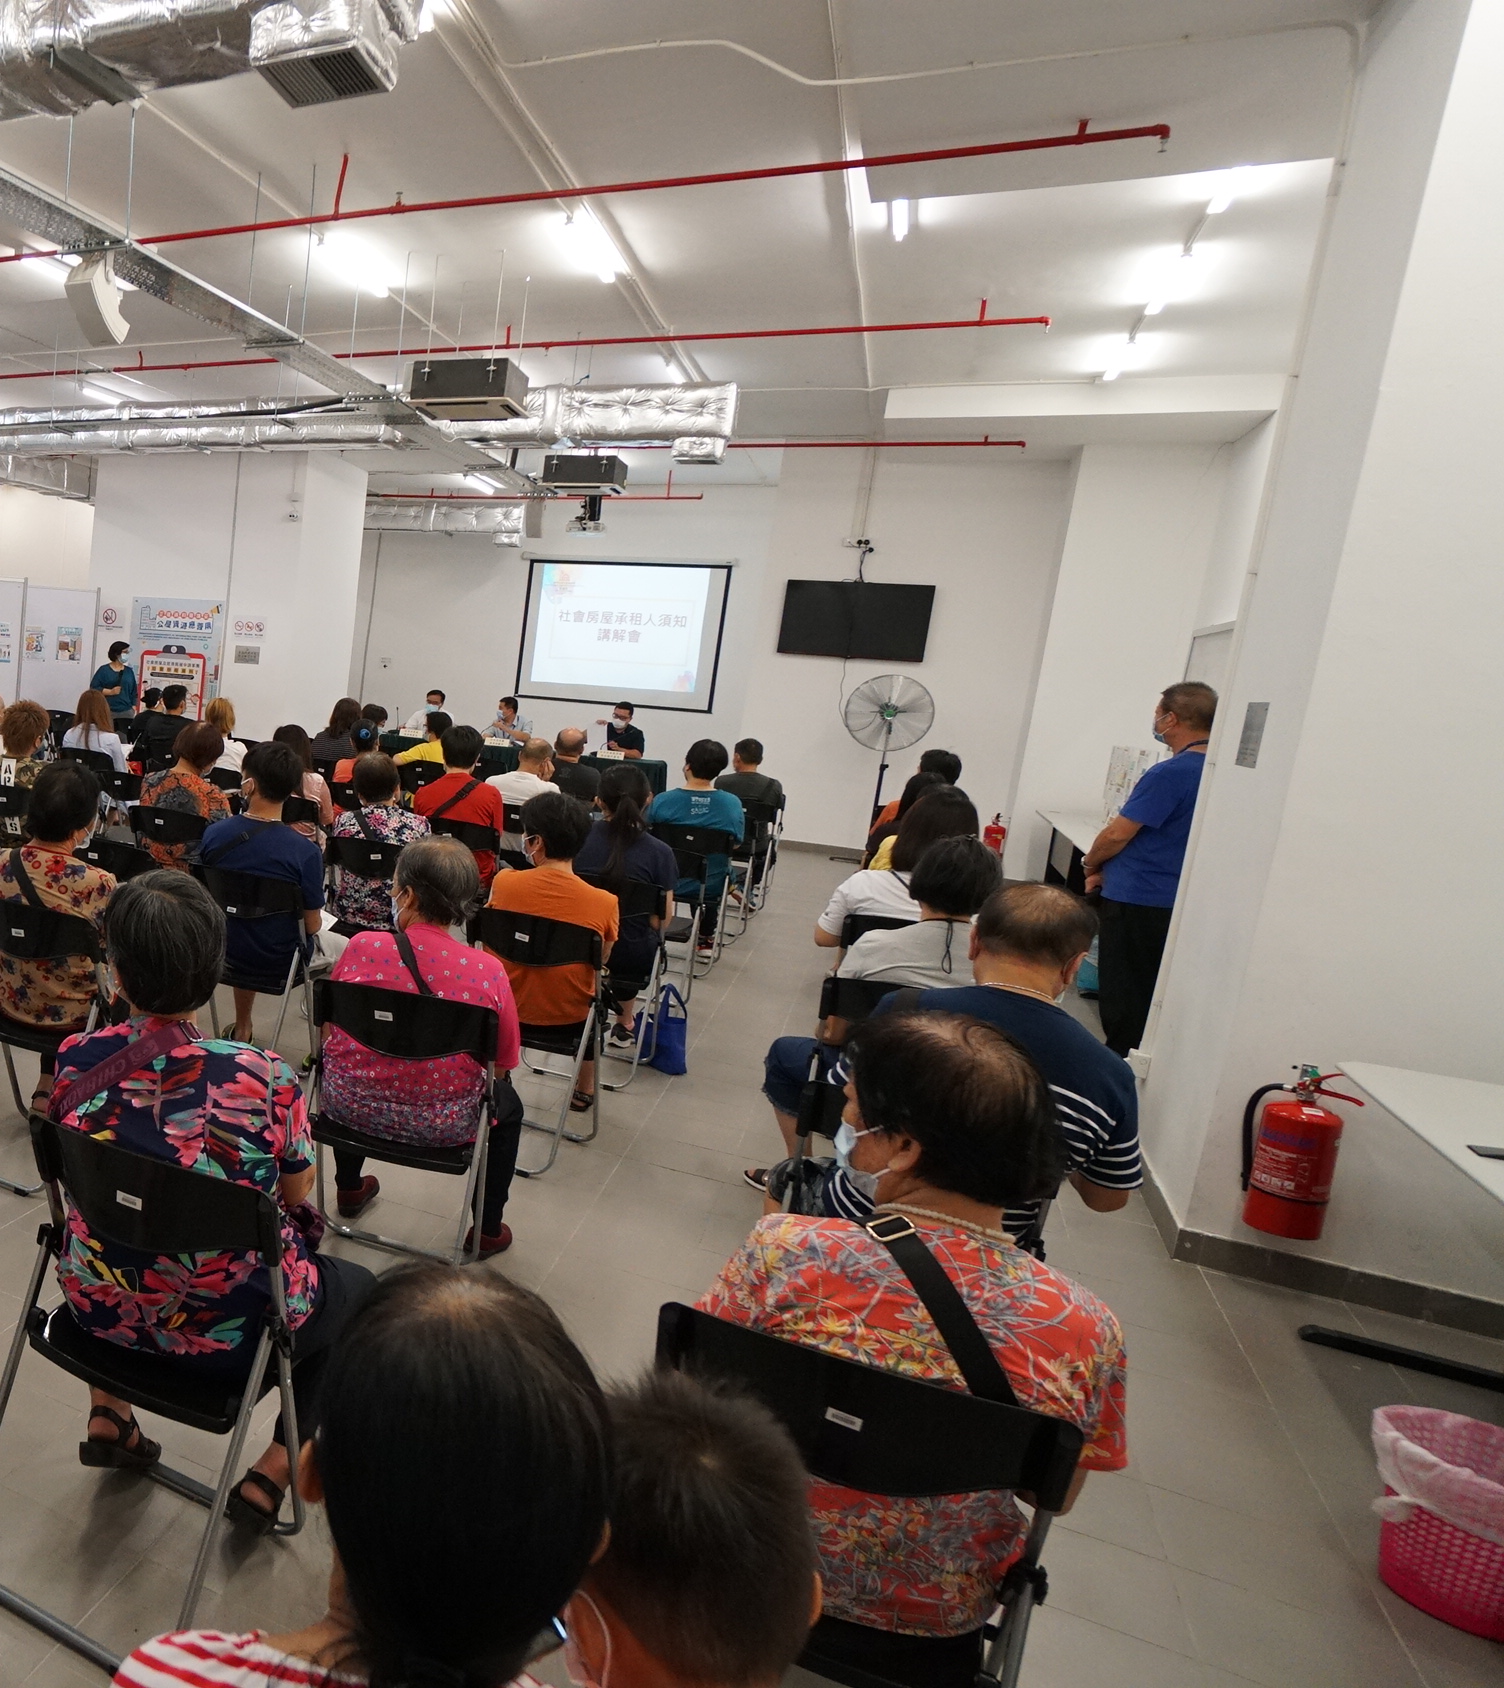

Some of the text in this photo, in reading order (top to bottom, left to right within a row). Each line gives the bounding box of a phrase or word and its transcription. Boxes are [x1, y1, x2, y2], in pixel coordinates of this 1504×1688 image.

[558, 609, 688, 628] 社會房屋承租人須知
[597, 628, 642, 643] 講解會
